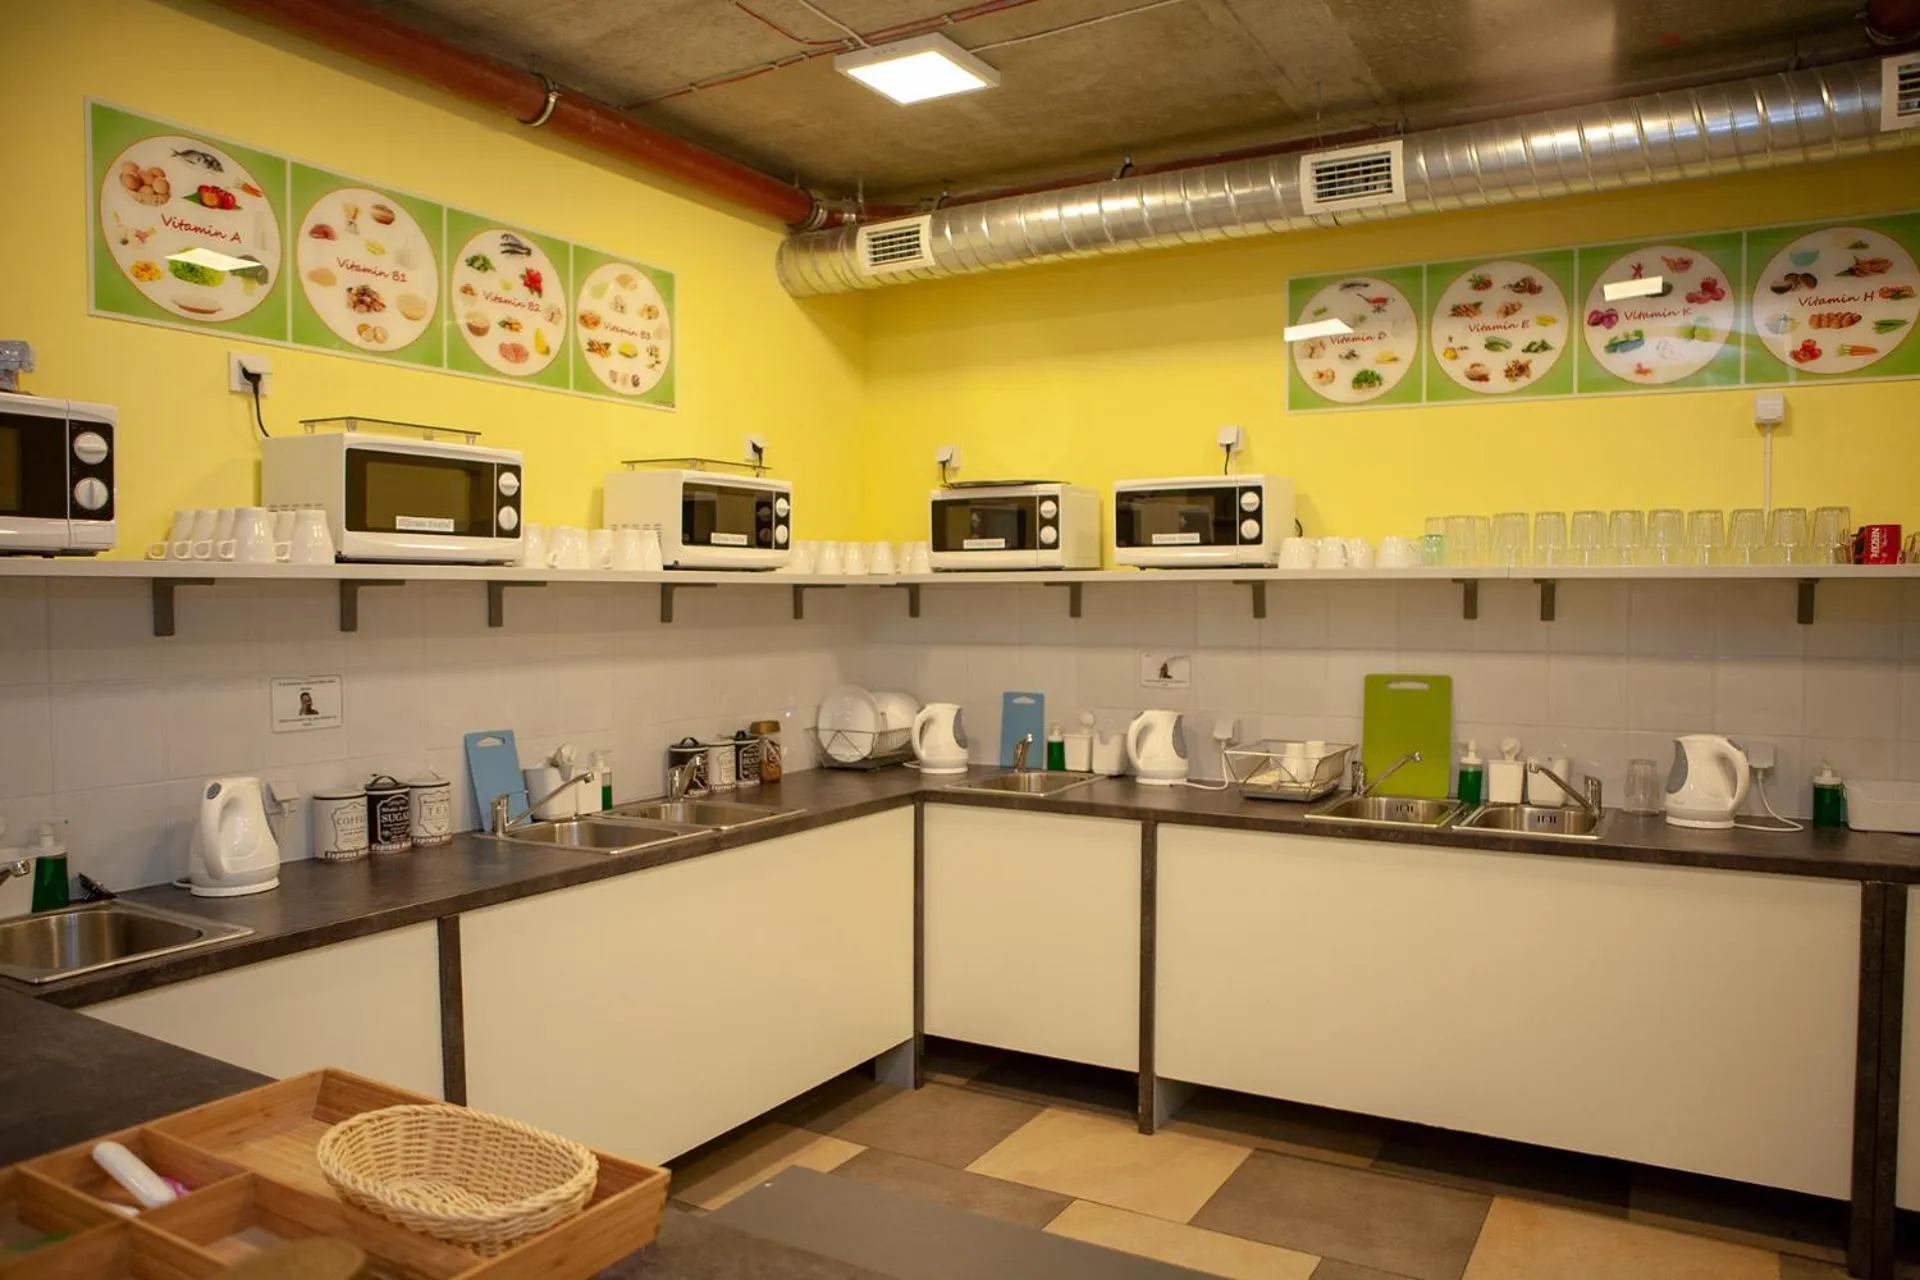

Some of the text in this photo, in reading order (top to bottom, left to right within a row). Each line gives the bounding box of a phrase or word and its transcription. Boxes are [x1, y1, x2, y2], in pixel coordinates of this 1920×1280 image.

[161, 213, 242, 244] Vitamin A
[336, 257, 408, 283] Vitamin B1
[483, 291, 542, 312] Vitamin B2
[1797, 290, 1875, 307] Vitamin H
[1624, 306, 1692, 321] Vitamin K
[603, 322, 638, 337] Vitamin
[1468, 319, 1531, 333] Vitamin E
[1329, 331, 1387, 345] Vitamin D
